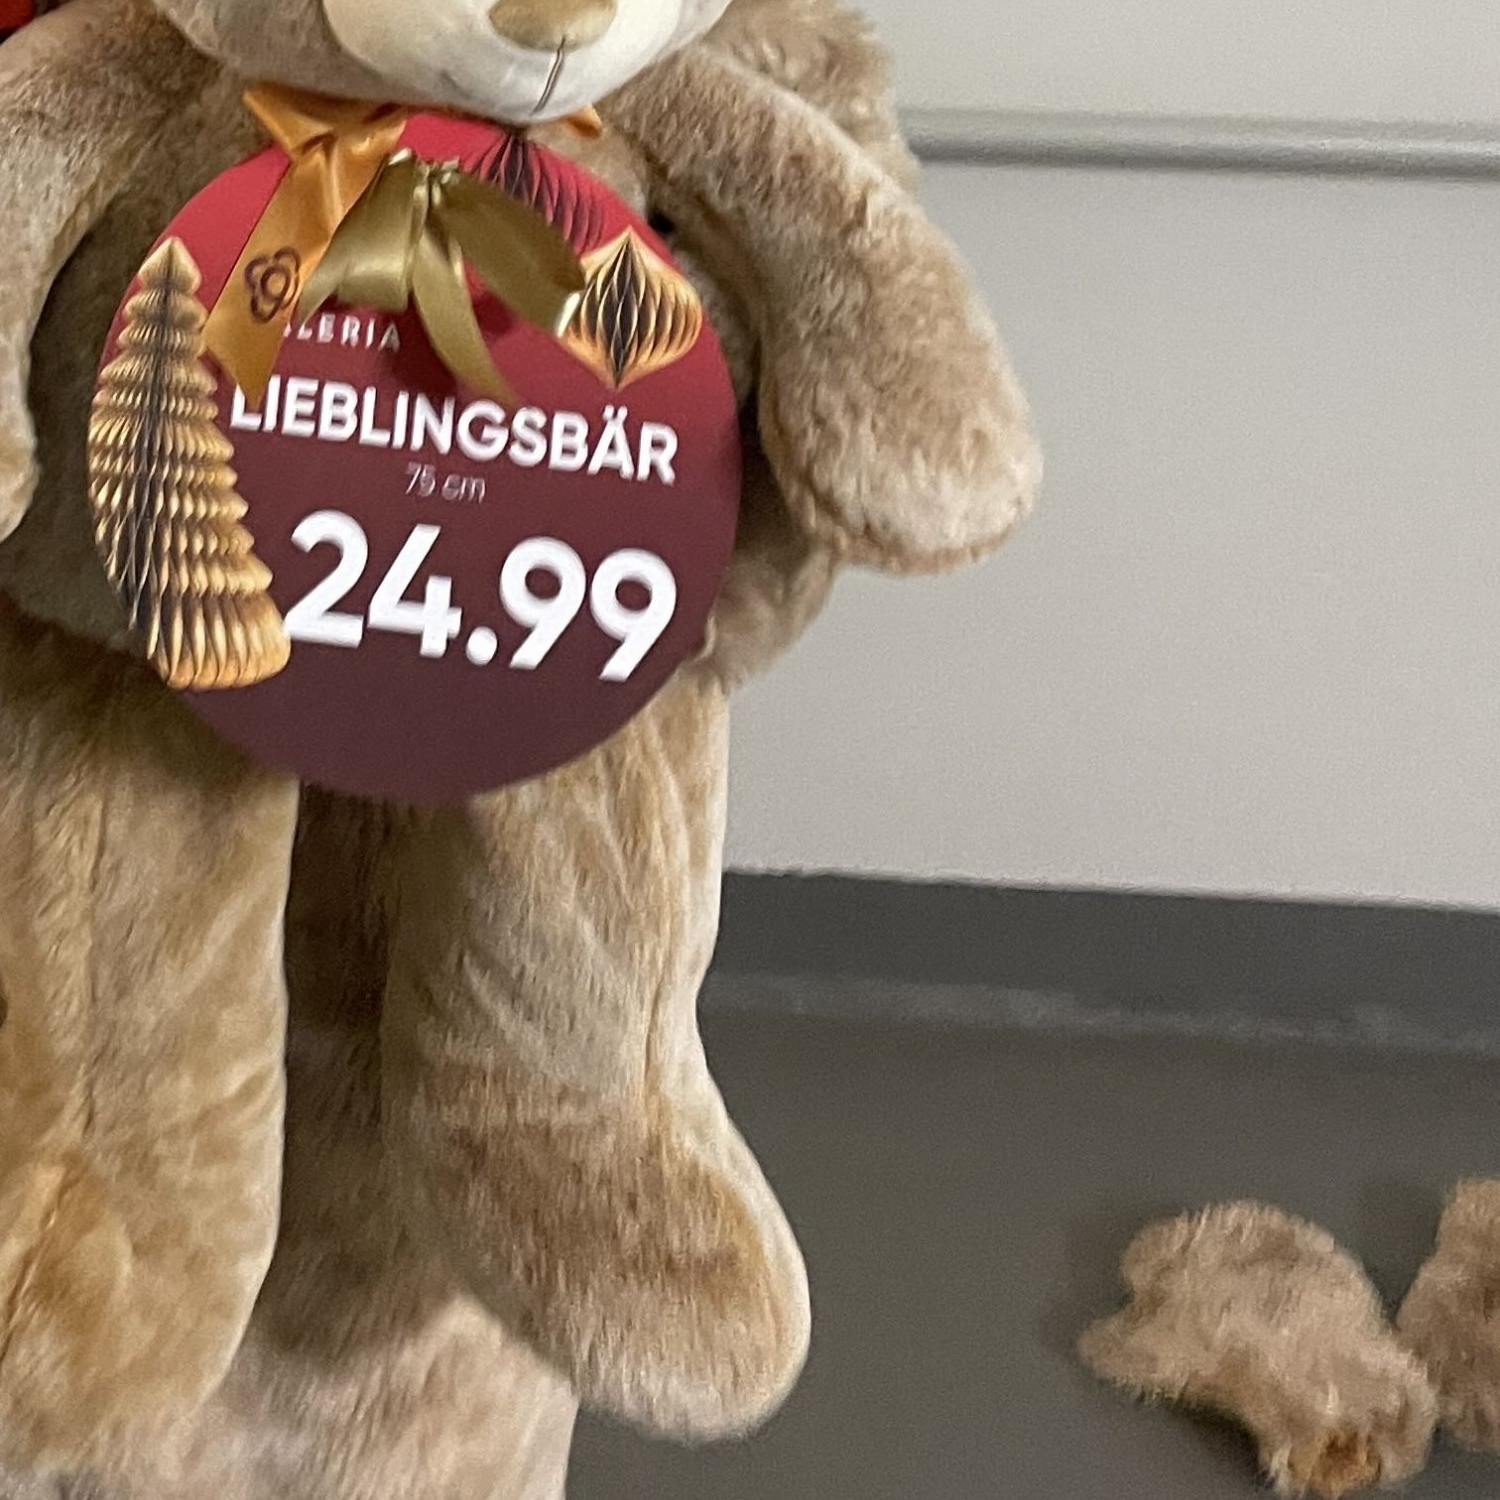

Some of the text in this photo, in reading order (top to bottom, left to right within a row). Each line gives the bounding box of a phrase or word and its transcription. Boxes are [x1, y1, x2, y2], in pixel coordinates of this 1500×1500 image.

[283, 311, 401, 352] LERIA
[230, 373, 678, 486] LIEBLINGSBÄR
[405, 461, 486, 504] 75 cm
[283, 509, 677, 683] 24.99
